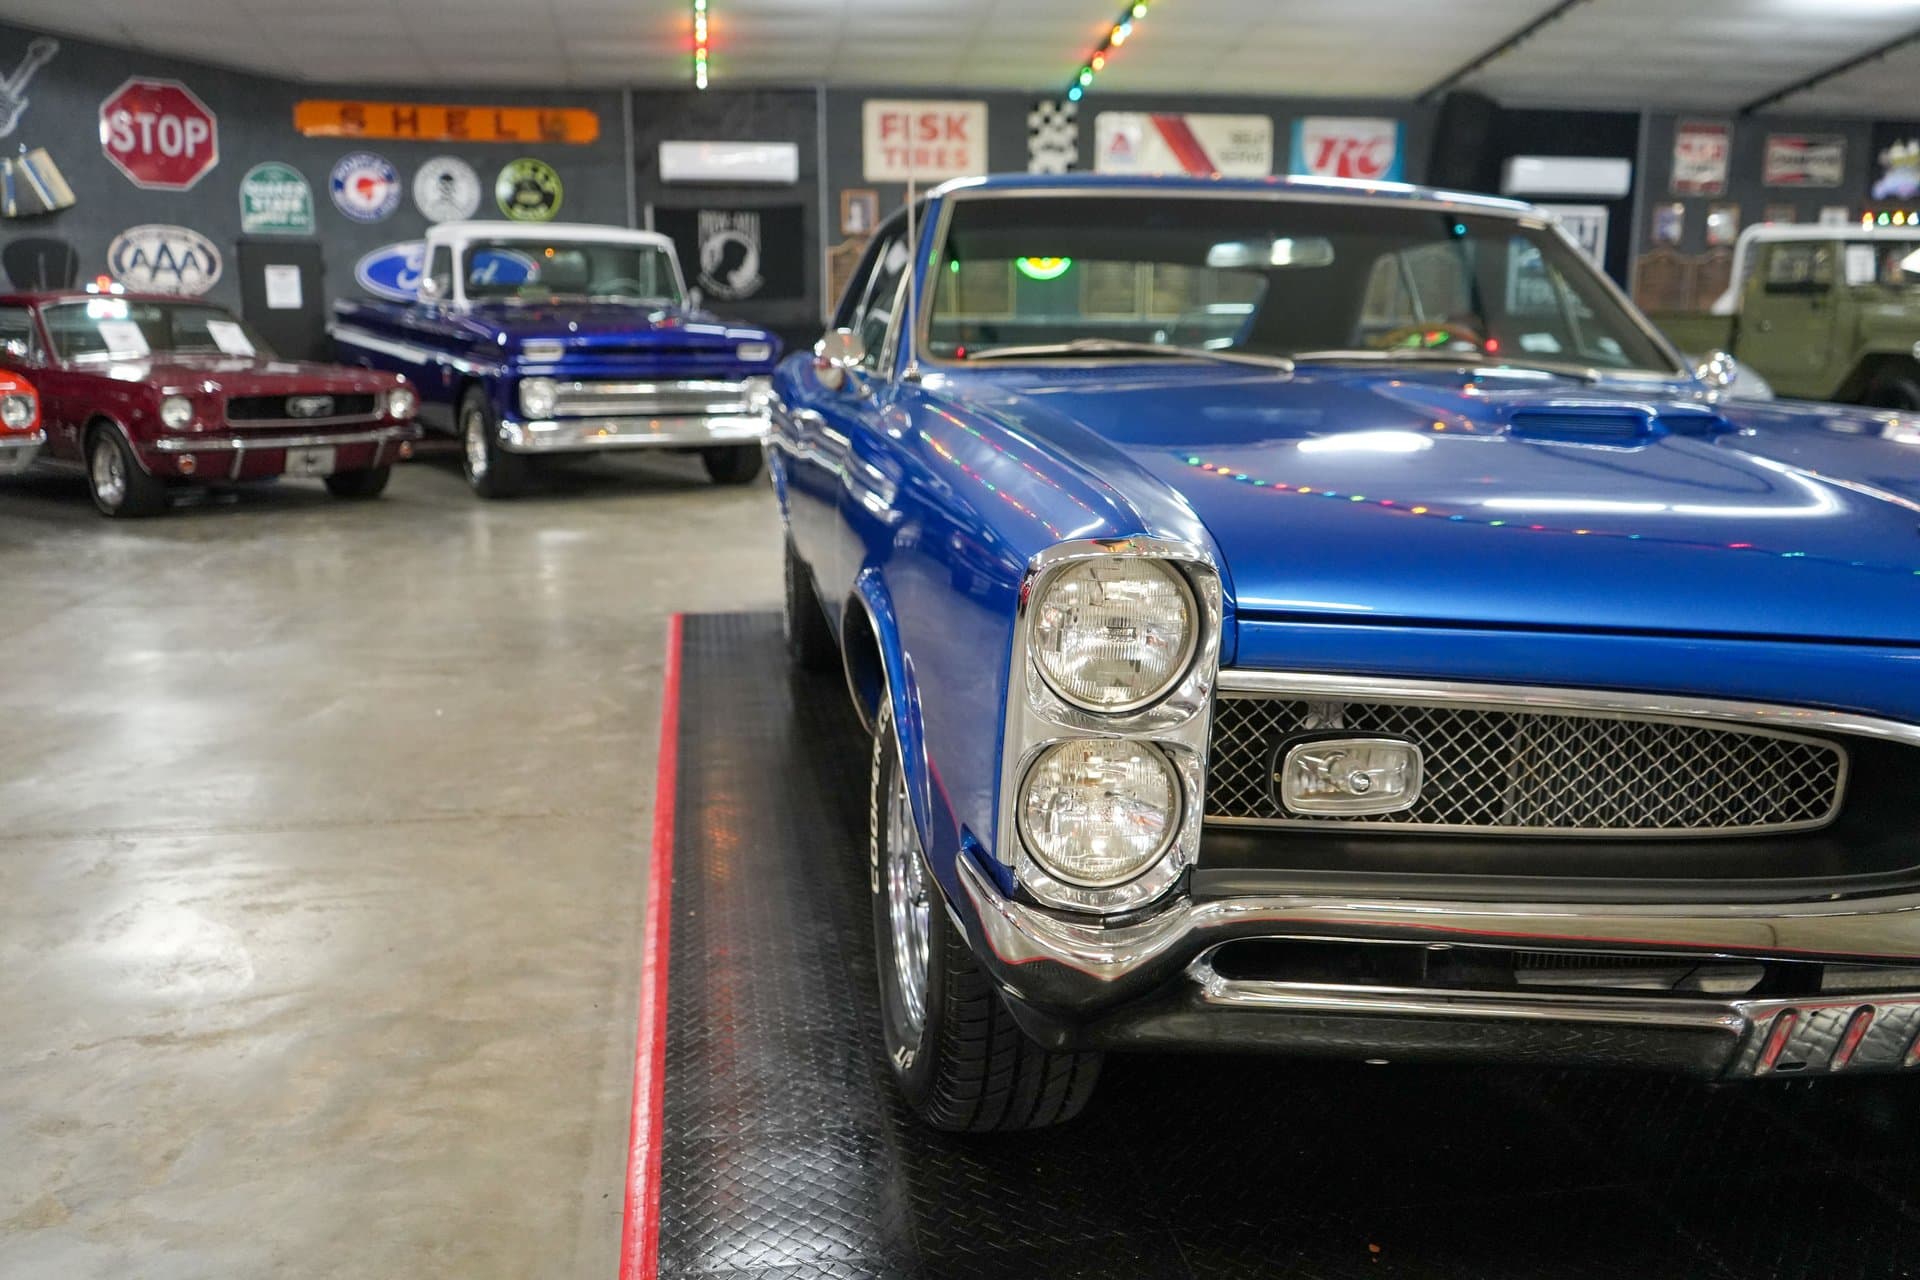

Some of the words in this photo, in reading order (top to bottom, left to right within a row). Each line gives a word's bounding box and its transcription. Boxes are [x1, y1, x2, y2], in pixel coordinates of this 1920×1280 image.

[111, 109, 209, 159] STOP
[880, 112, 969, 141] FISK
[884, 147, 970, 168] TIRES
[1314, 136, 1392, 179] RC
[131, 243, 201, 281] AAA
[870, 735, 882, 895] COOPER
